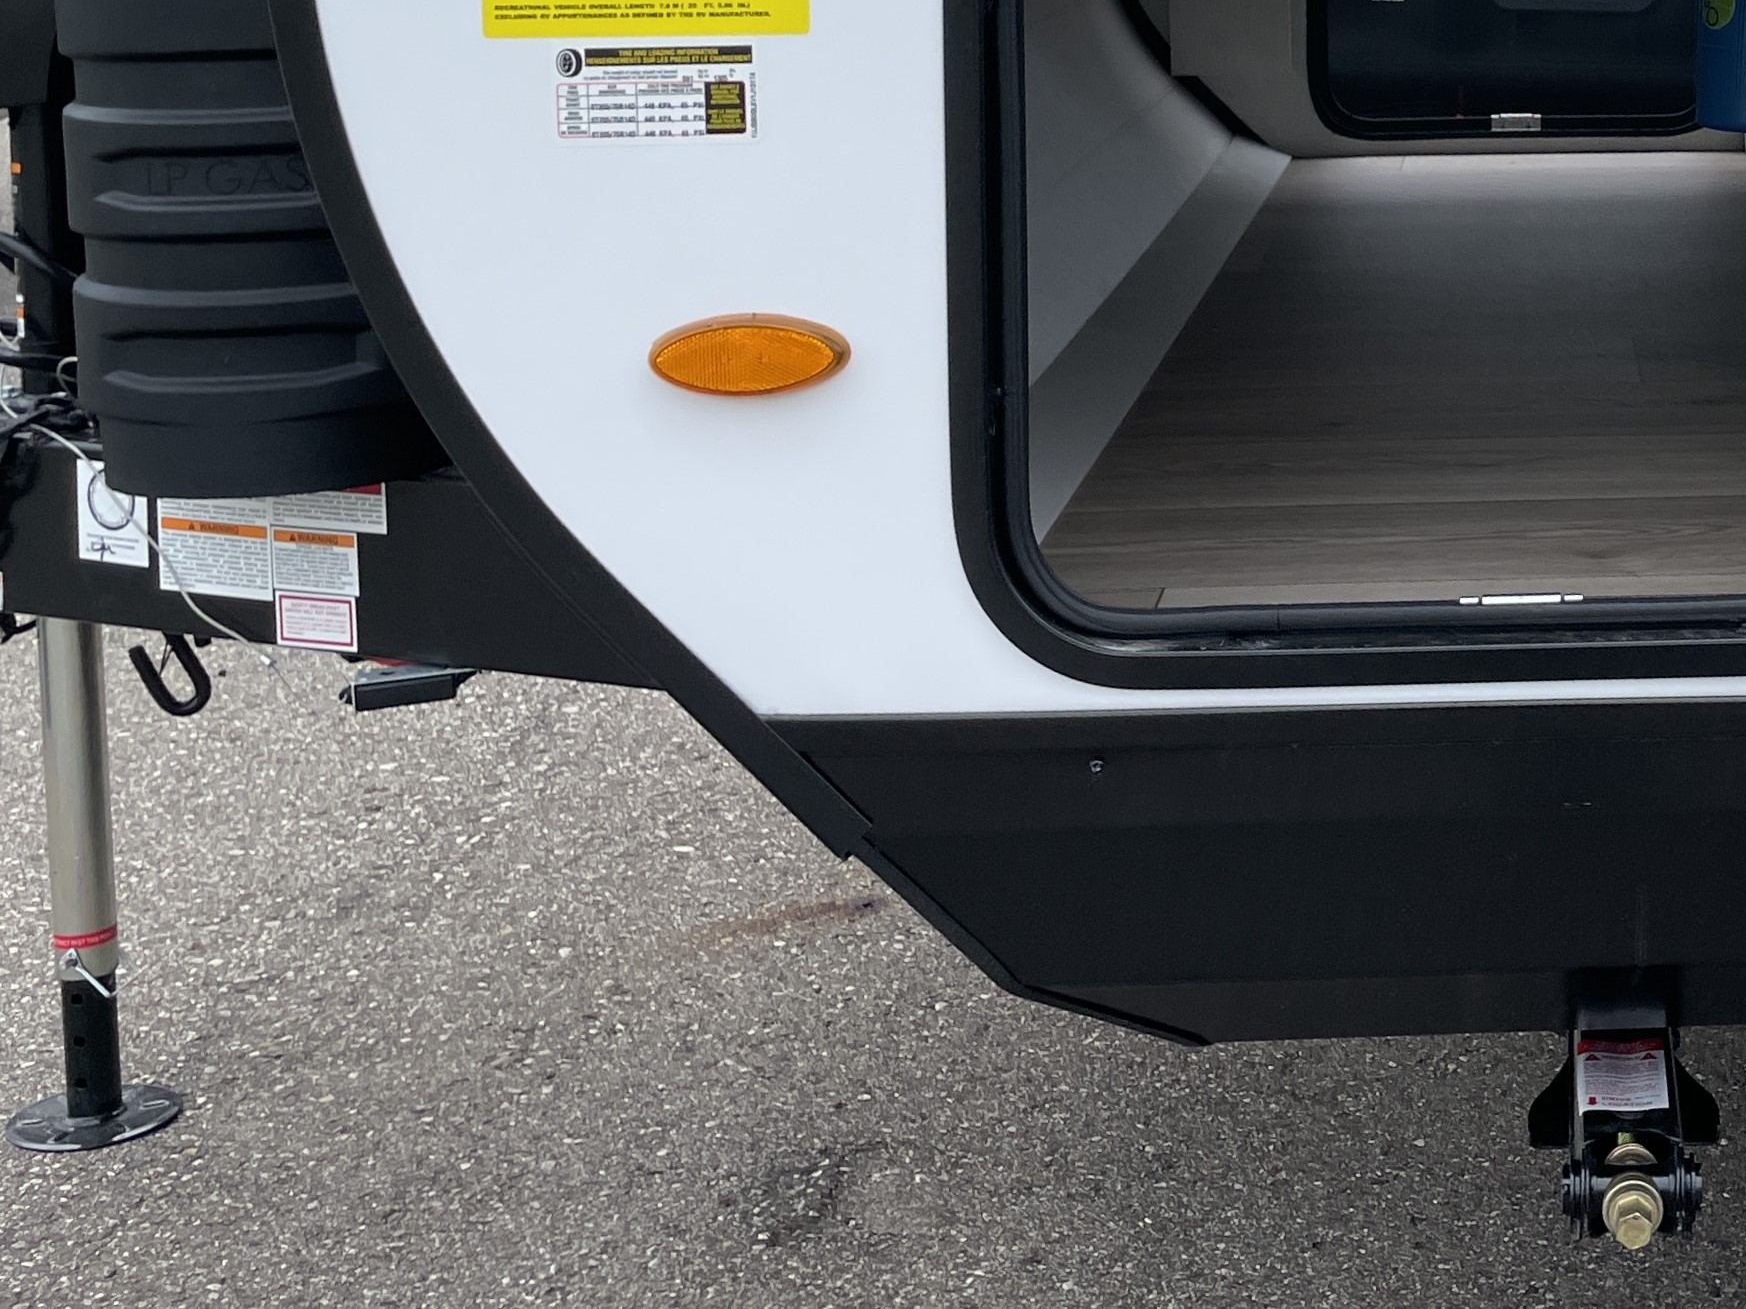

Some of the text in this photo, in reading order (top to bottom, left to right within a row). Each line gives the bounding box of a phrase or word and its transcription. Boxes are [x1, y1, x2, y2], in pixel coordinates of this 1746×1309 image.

[205, 157, 310, 195] GAS
[199, 523, 240, 535] WARNING
[298, 534, 339, 545] WARNING
